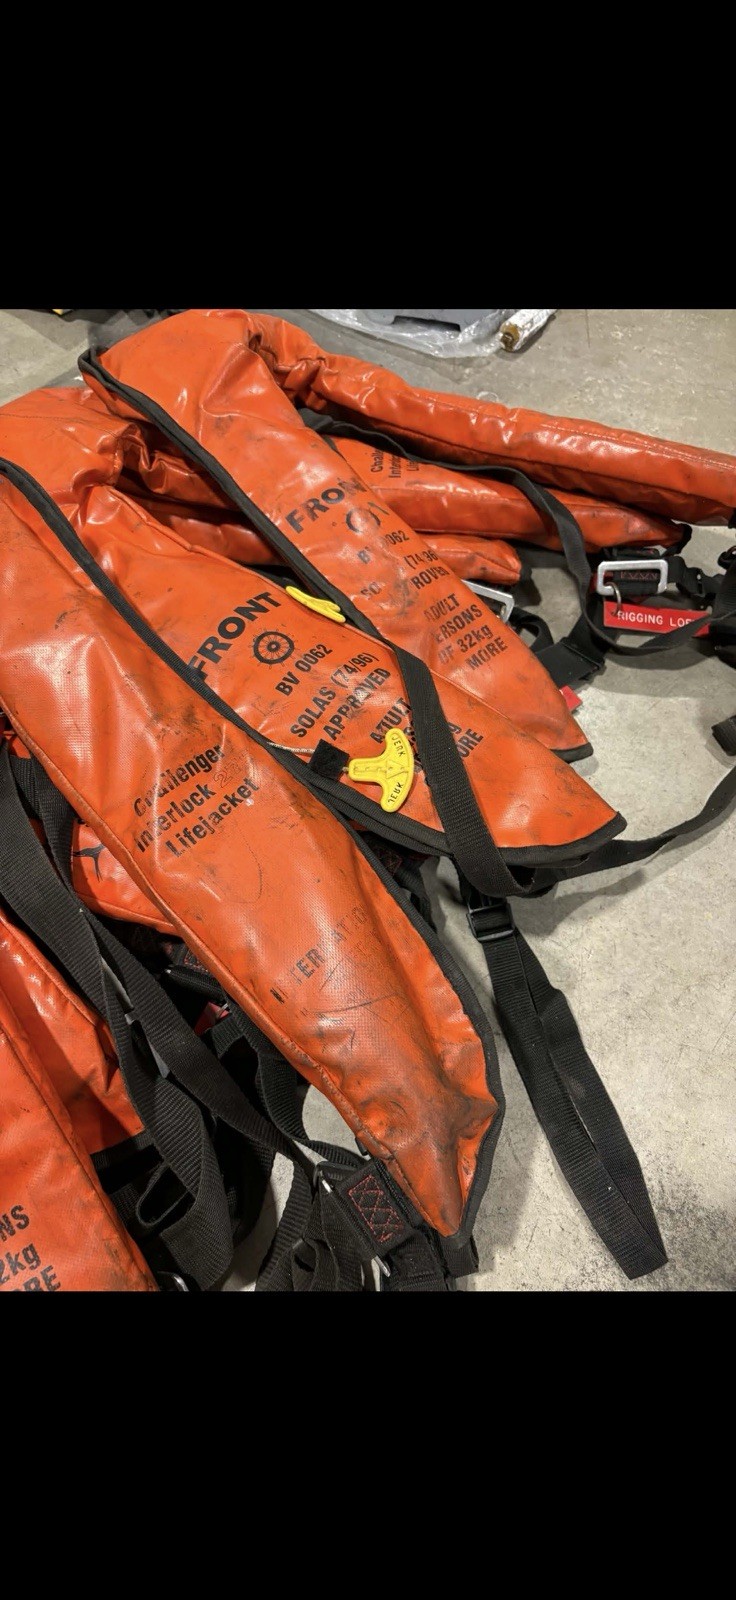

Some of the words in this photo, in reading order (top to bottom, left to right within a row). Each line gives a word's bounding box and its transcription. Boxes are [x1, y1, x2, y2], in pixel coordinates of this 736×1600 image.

[285, 476, 368, 534] FRON
[189, 591, 281, 681] FRONT
[457, 624, 494, 653] 32kg
[617, 610, 664, 625] RIGGING
[275, 672, 300, 696] BV
[295, 643, 333, 679] 0062
[465, 636, 508, 670] MORE
[290, 685, 336, 739] SOLAS
[330, 652, 380, 690] (74/96)
[322, 667, 392, 741] APPROVED
[391, 735, 406, 758] JERK
[165, 777, 259, 857] Lifejacket
[387, 781, 404, 803] JERK
